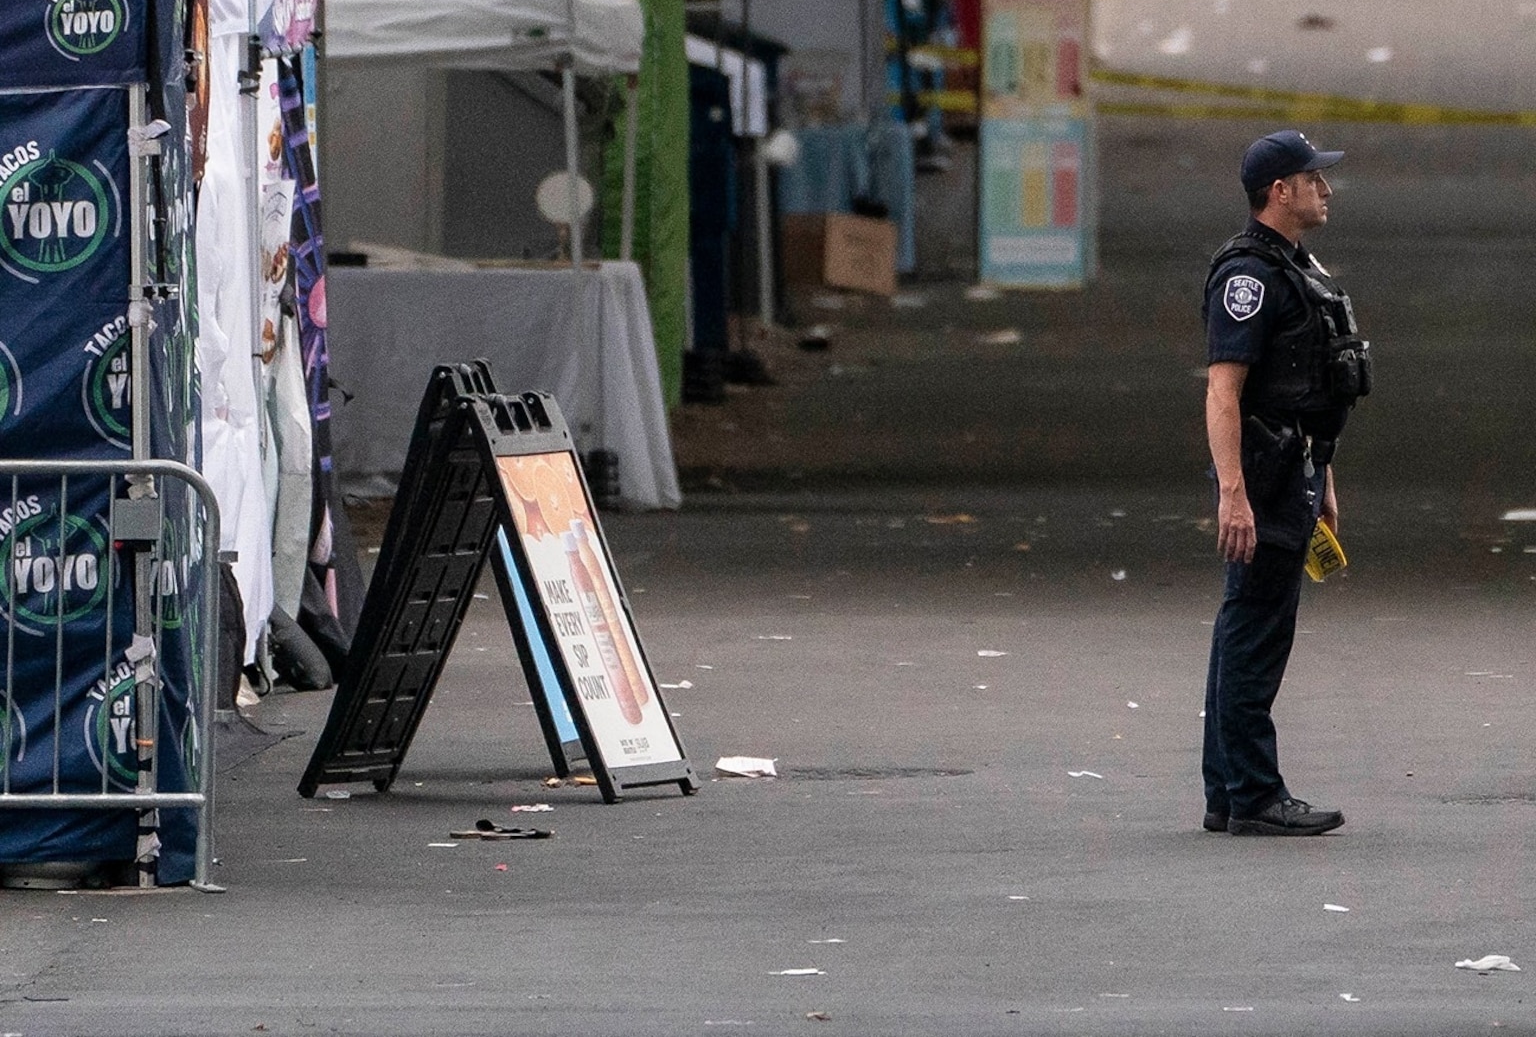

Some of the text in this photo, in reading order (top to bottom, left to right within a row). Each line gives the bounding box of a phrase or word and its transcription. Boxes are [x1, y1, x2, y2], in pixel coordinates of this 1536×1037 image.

[63, 0, 75, 13] el
[61, 10, 114, 36] YOYO
[11, 182, 30, 202] el
[8, 200, 96, 239] YOYO
[1233, 279, 1260, 292] SEATTLE
[1231, 303, 1252, 313] POLICE
[84, 315, 130, 357] TACO
[110, 351, 127, 373] el
[0, 494, 41, 540] ACOS
[15, 536, 31, 557] el
[14, 553, 98, 594] YOYO
[543, 579, 574, 604] MAKE
[553, 611, 586, 637] EVERY
[572, 644, 590, 668] SIP
[577, 675, 611, 700] COUNT
[112, 695, 130, 715] el
